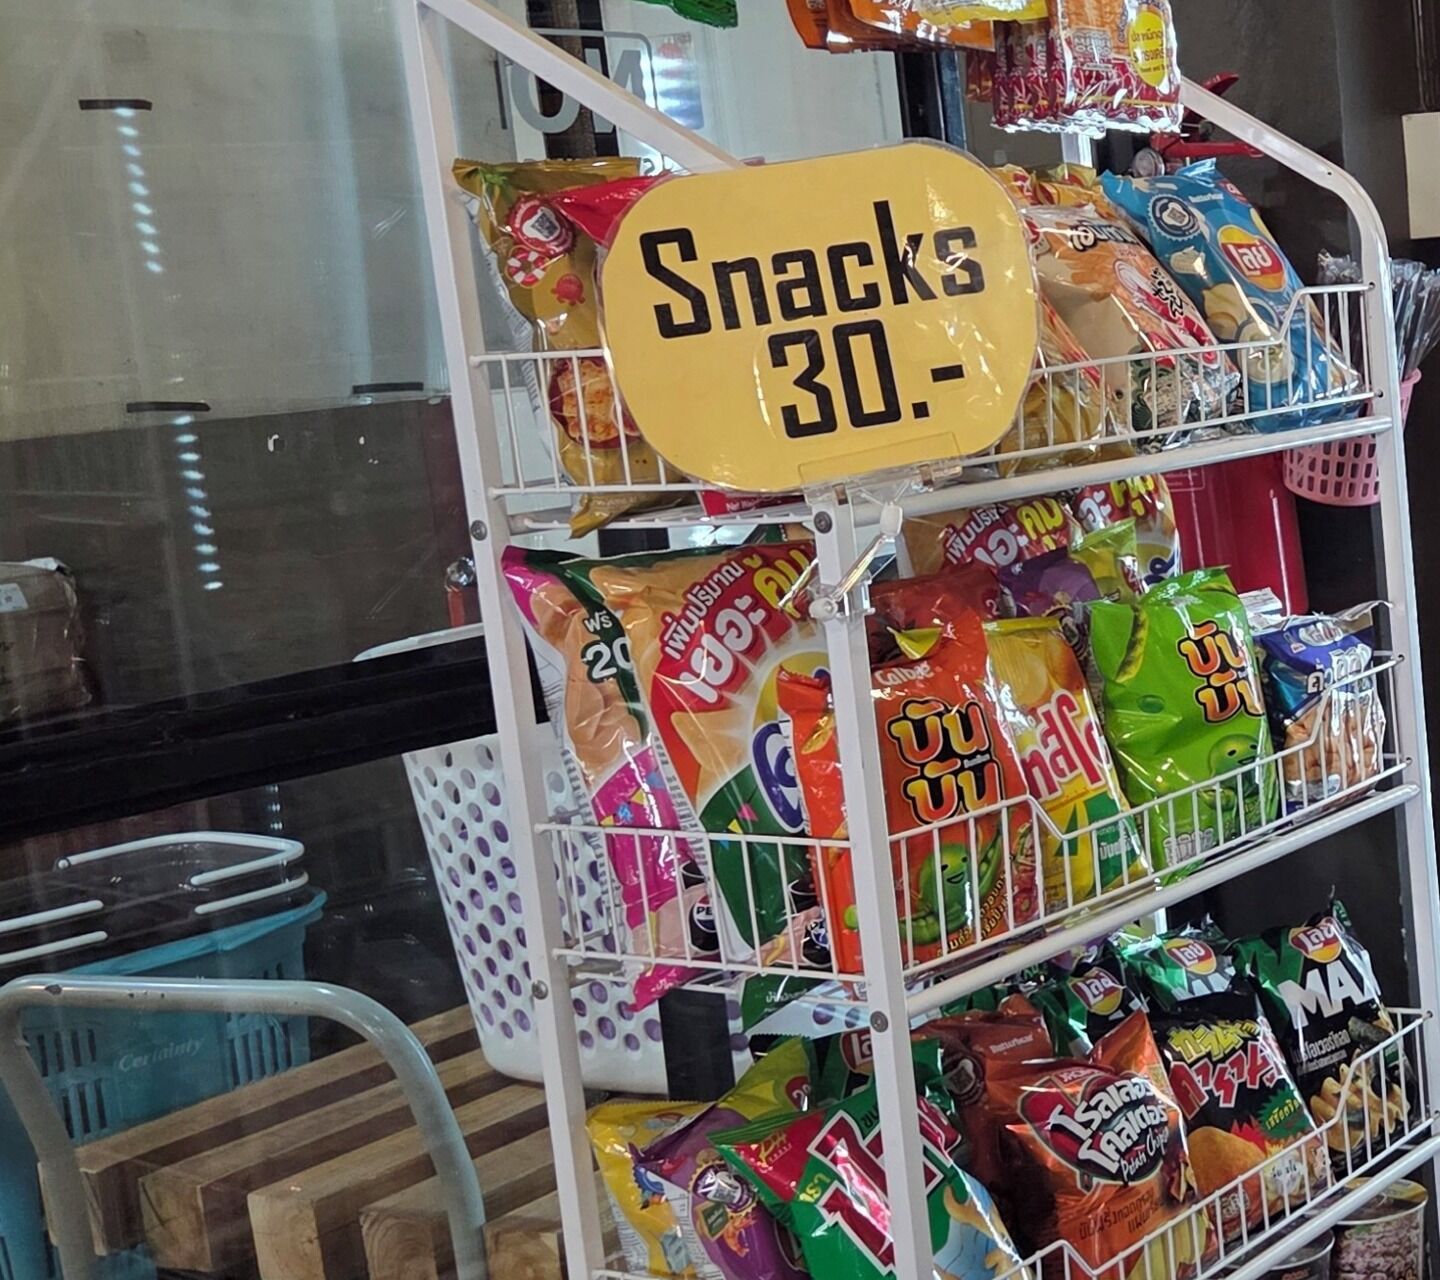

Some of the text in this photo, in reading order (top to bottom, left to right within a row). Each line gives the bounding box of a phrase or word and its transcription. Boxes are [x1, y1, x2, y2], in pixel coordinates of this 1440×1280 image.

[638, 200, 987, 339] Snacks
[767, 319, 965, 439] 30.-
[680, 595, 766, 704] เยอะ
[119, 1036, 205, 1073] Certainty
[1120, 1125, 1170, 1182] Potato Chips
